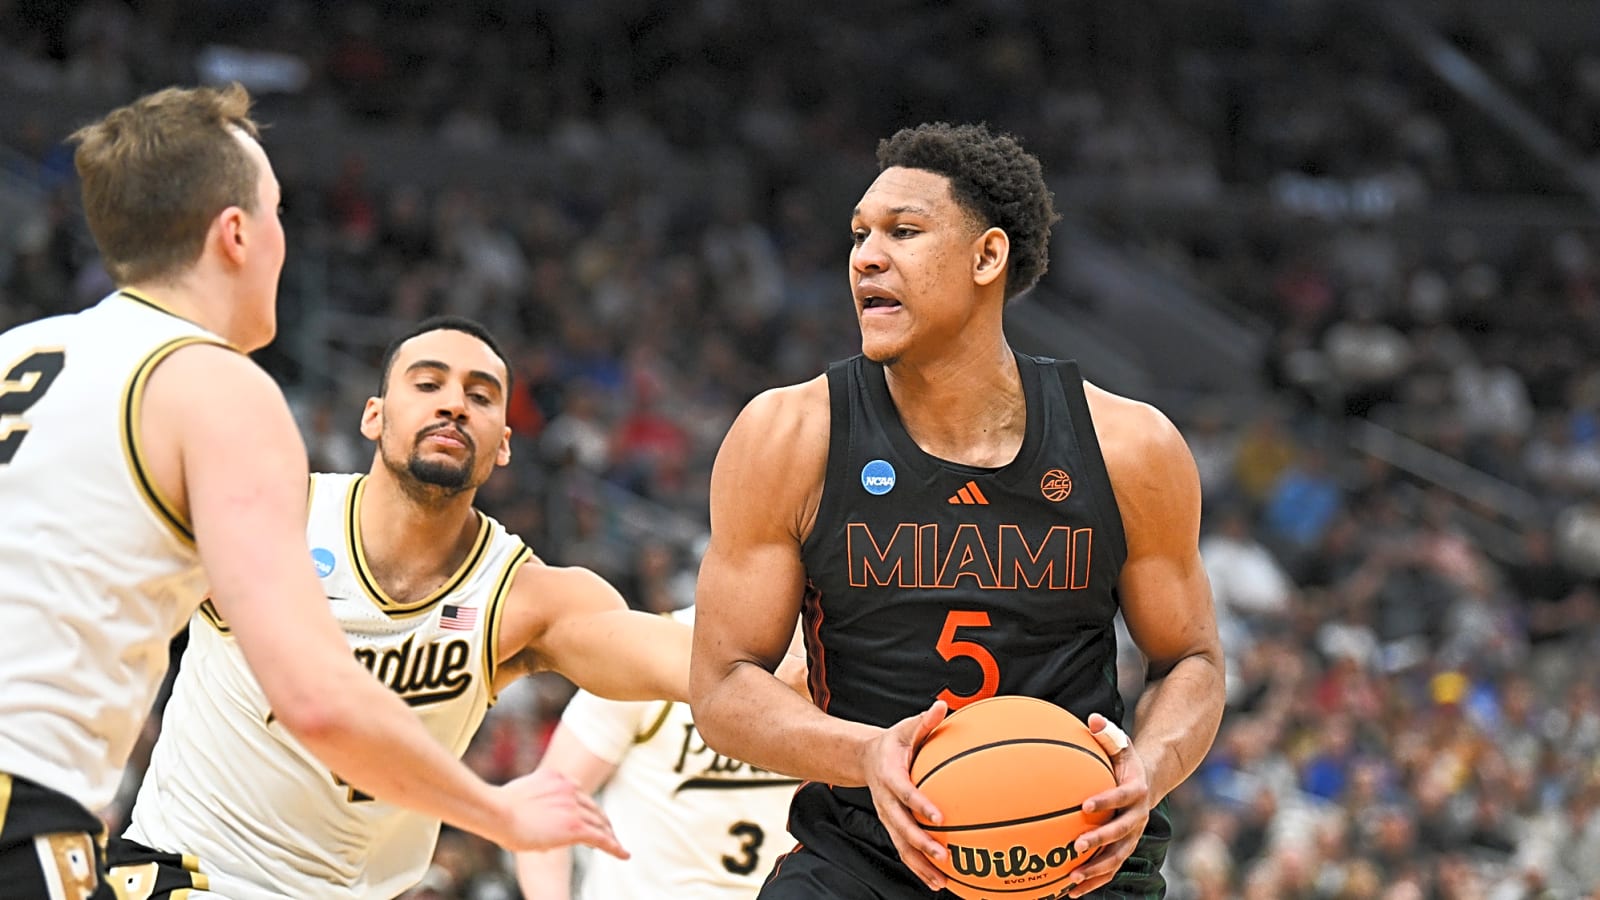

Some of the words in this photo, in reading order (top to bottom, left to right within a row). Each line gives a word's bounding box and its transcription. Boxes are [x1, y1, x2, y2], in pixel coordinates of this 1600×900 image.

[865, 476, 894, 487] NCAA
[847, 523, 1093, 590] MIAMI
[935, 610, 1000, 710] 5
[721, 820, 765, 876] 3
[1028, 873, 1048, 882] NXT
